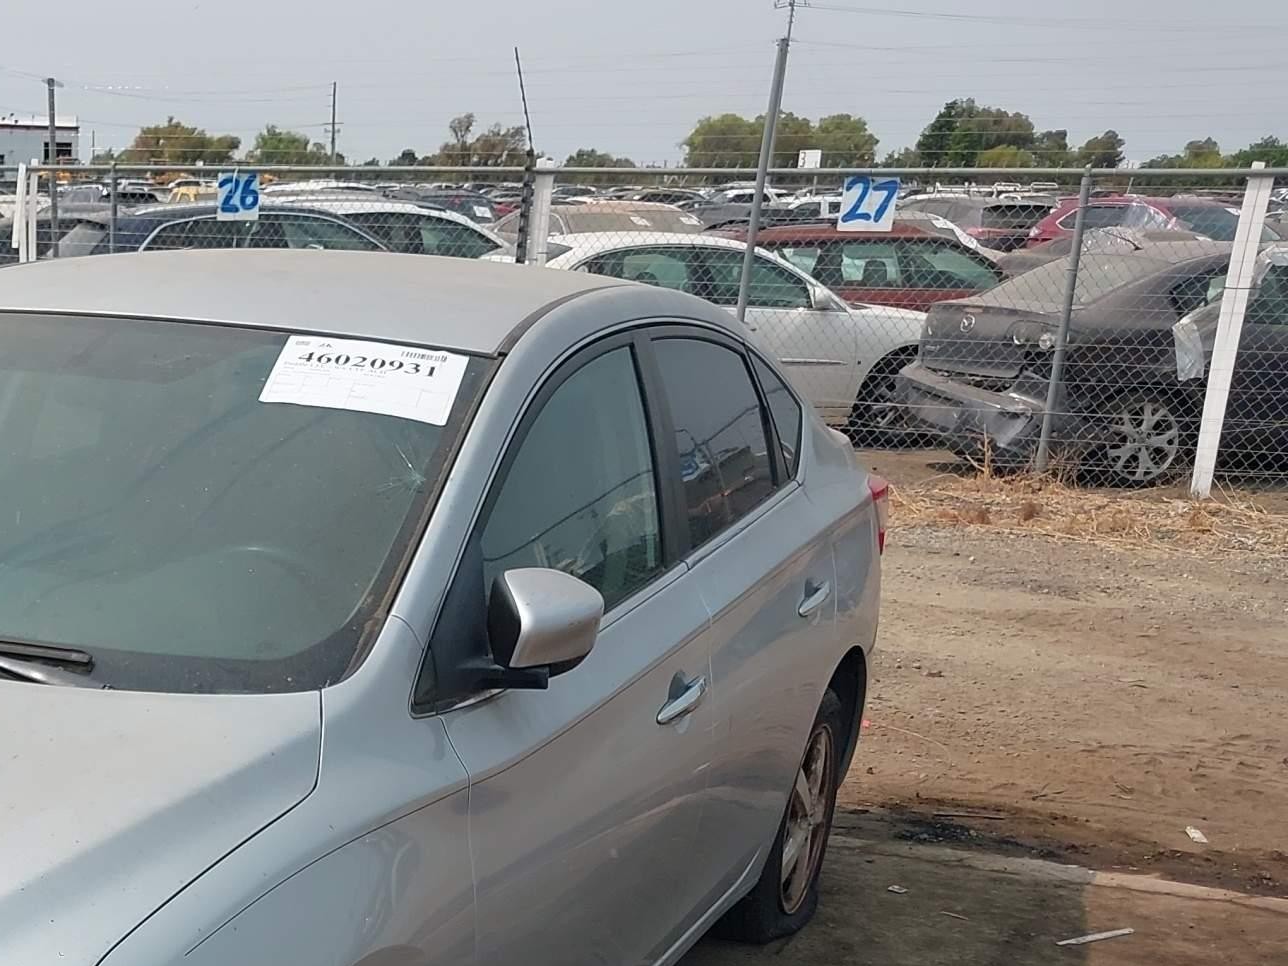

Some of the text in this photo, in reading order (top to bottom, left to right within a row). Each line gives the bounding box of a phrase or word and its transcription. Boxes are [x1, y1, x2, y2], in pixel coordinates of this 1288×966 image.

[218, 172, 259, 213] 26
[840, 175, 899, 223] 27
[297, 350, 438, 378] 46020931
